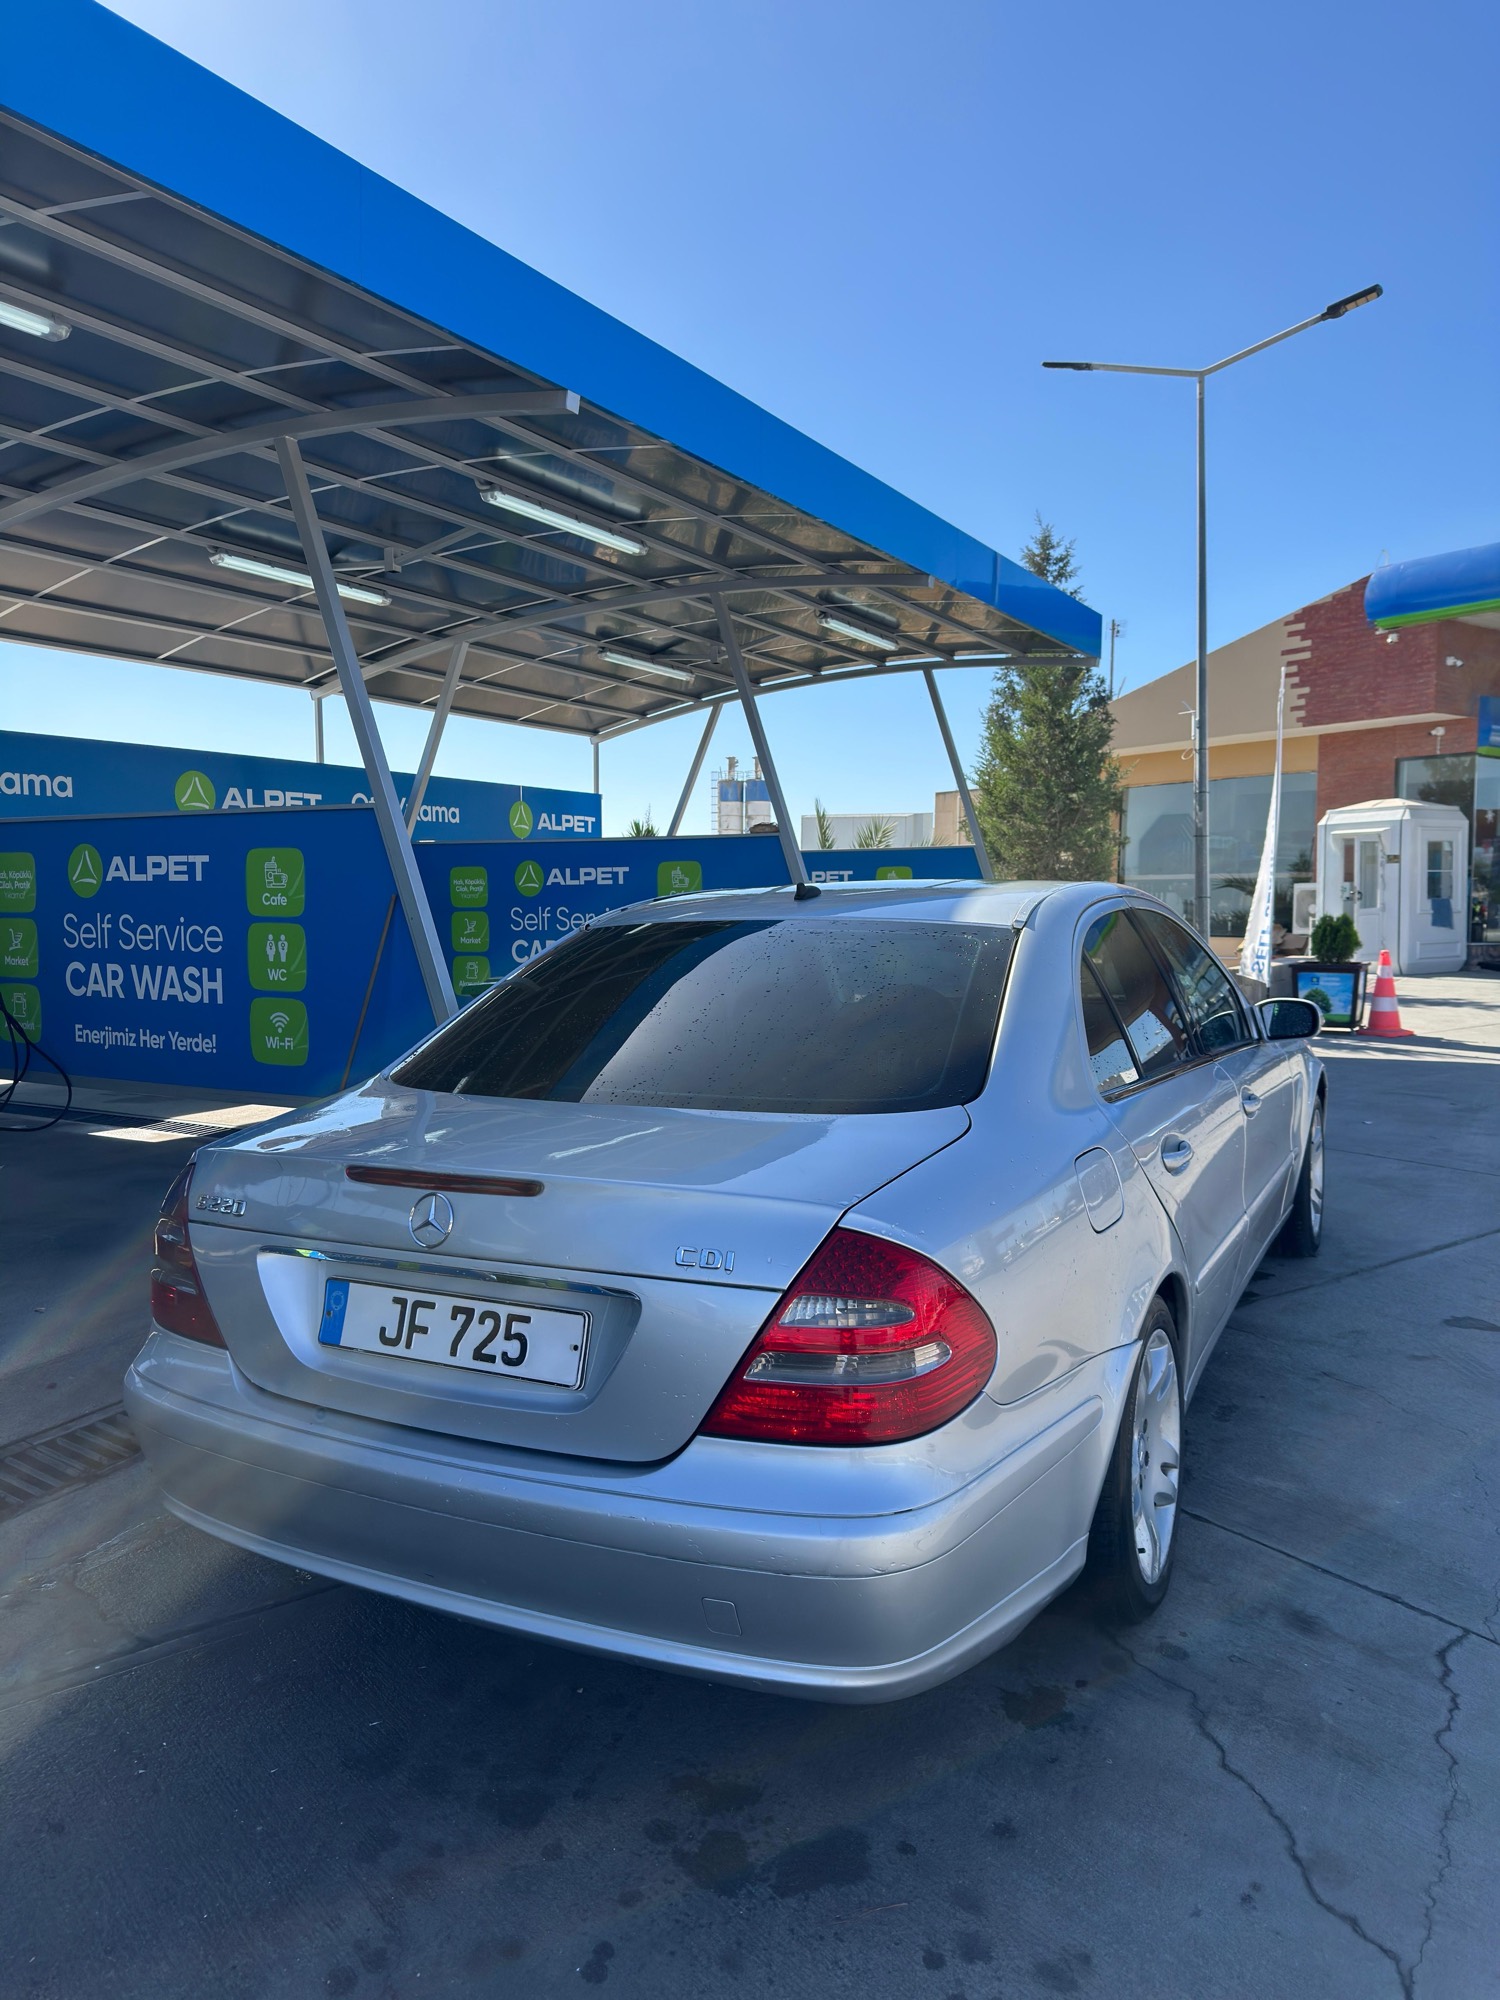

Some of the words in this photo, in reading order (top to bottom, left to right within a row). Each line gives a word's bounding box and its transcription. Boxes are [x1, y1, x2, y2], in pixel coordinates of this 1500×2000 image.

[0, 771, 73, 798] ama
[222, 787, 322, 809] ALPET
[537, 813, 595, 833] ALPET
[105, 855, 209, 882] ALPET
[546, 867, 629, 885] ALPET
[810, 871, 853, 883] PET
[262, 892, 288, 906] Cafe
[510, 906, 551, 931] Self
[63, 912, 112, 949] Self
[118, 914, 223, 953] Service
[5, 955, 29, 966] Market
[65, 961, 125, 999] CAR
[130, 964, 223, 1004] WASH
[267, 968, 287, 981] WC
[75, 1024, 136, 1050] Enerjimiz
[139, 1028, 165, 1049] Her
[168, 1030, 217, 1054] Yerde!
[265, 1035, 294, 1050] Wi-Fi
[196, 1195, 247, 1217] E220
[675, 1246, 735, 1271] CDI
[379, 1296, 436, 1350] JF
[449, 1305, 532, 1367] 725
